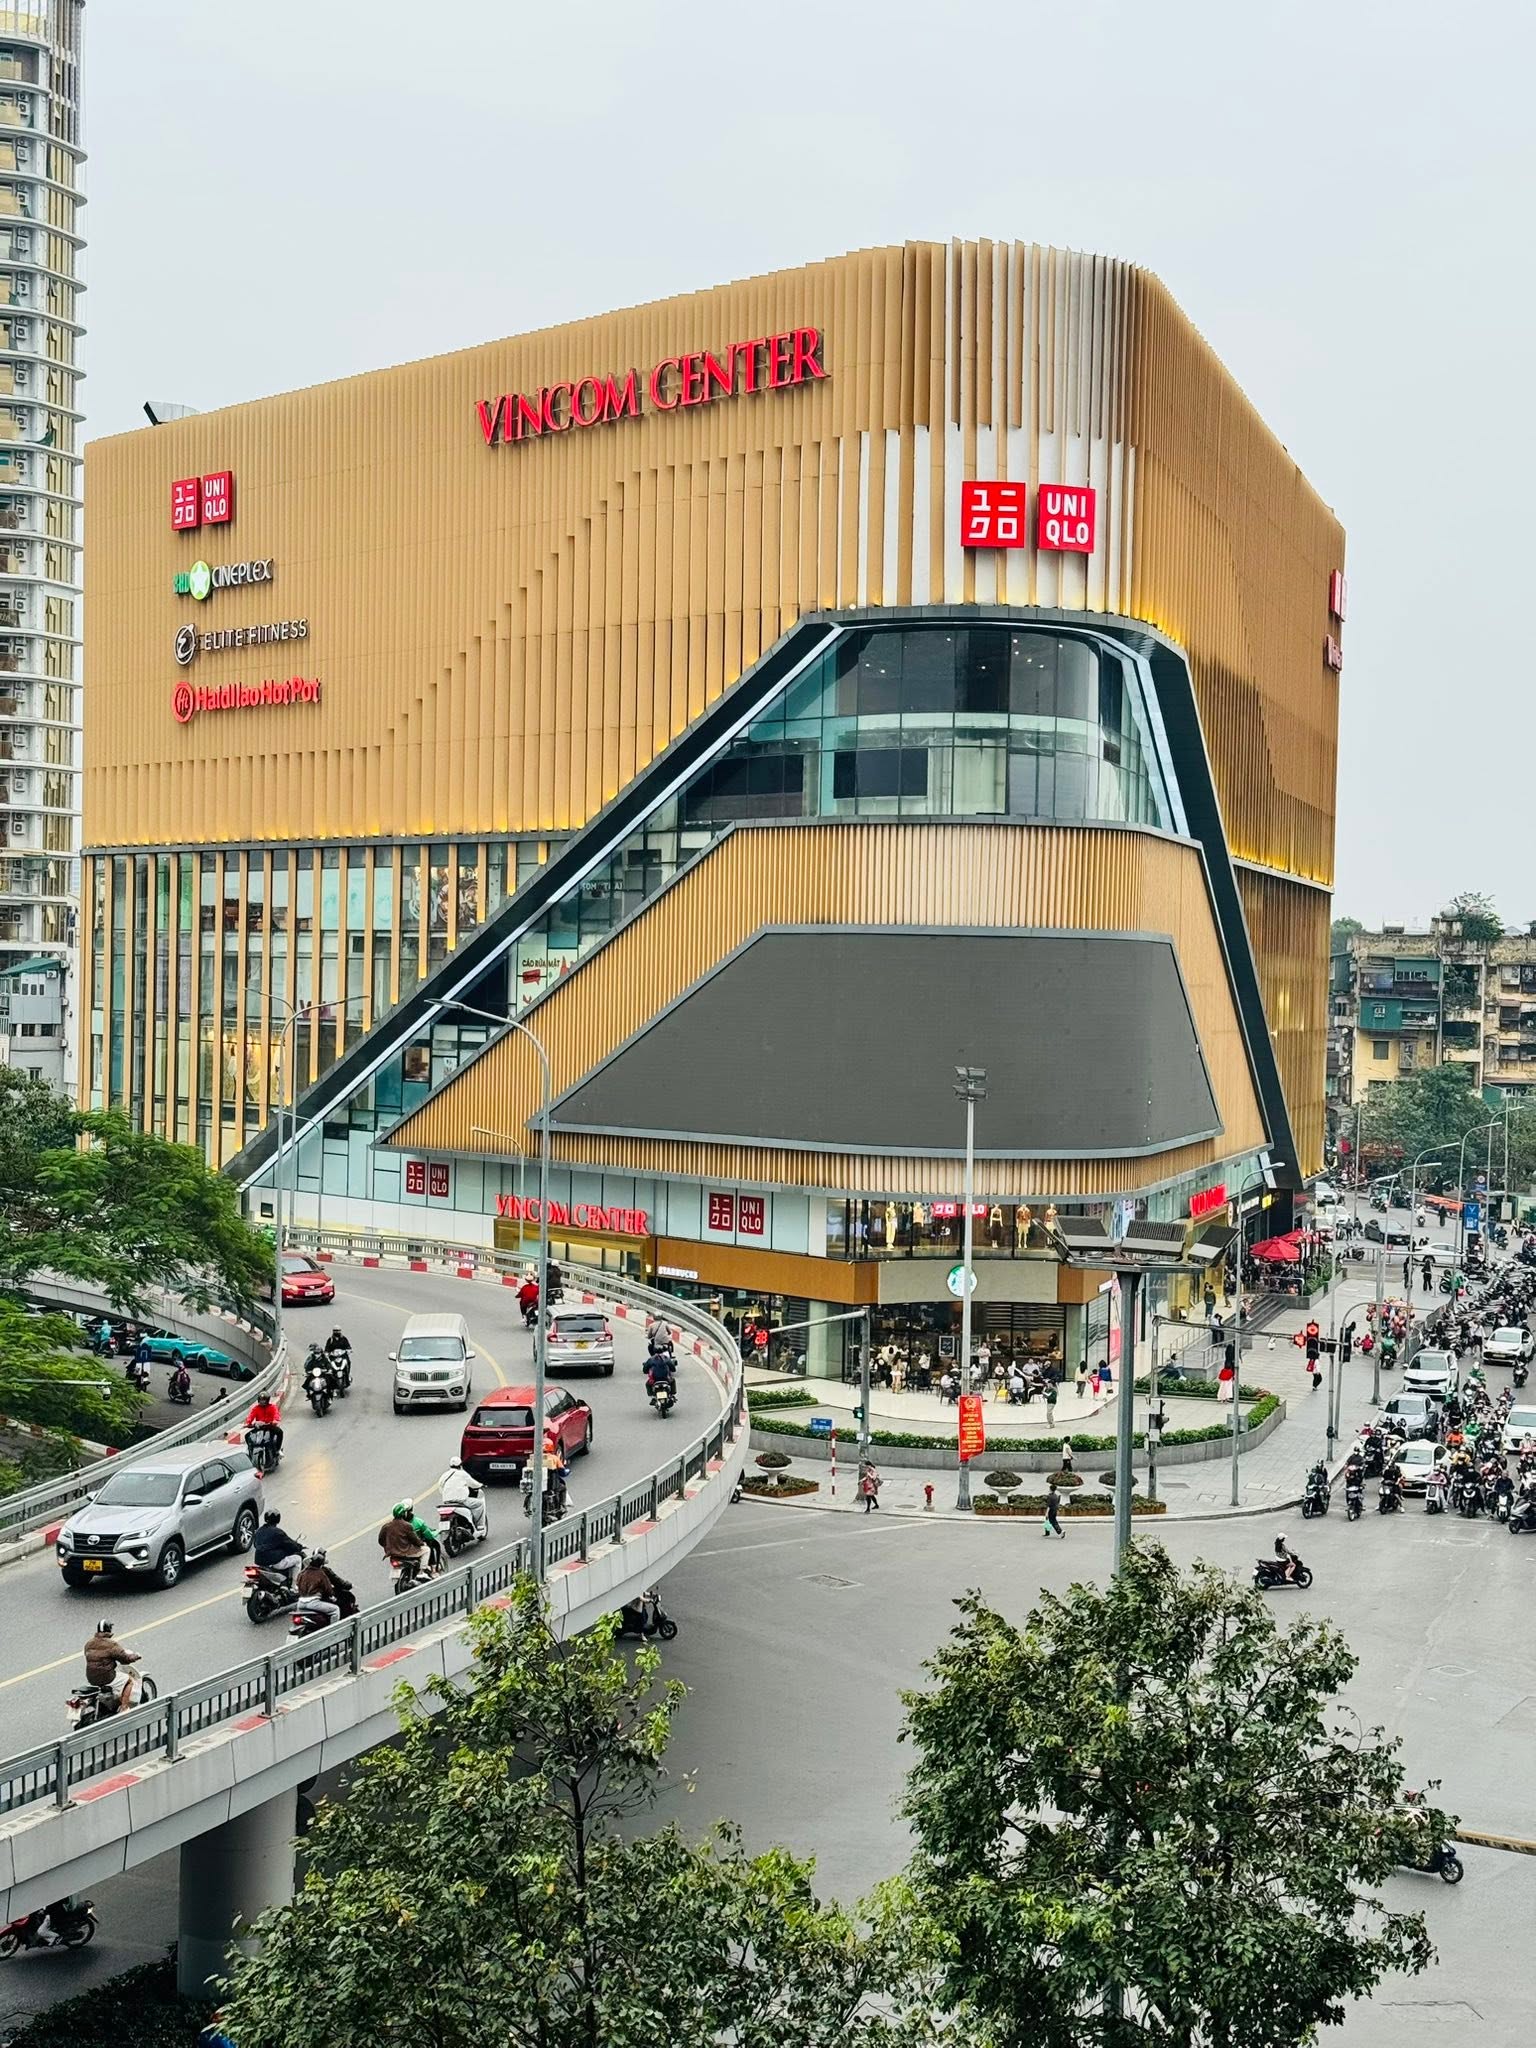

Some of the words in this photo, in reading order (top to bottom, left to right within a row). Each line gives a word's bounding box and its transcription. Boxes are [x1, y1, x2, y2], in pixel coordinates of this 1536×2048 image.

[475, 367, 643, 446] VINCOM
[650, 326, 831, 411] CENTER
[205, 477, 225, 498] UNI
[205, 498, 226, 520] QLO
[1046, 492, 1087, 518] UNI
[1045, 519, 1090, 546] QLO
[211, 559, 273, 588] CINEPLEX
[204, 629, 243, 650] ELITE
[249, 618, 308, 645] FITNESS
[495, 1193, 570, 1227] VINCOM
[573, 1203, 650, 1236] CENTER
[741, 1201, 760, 1215] UNI
[741, 1217, 761, 1231] QLO
